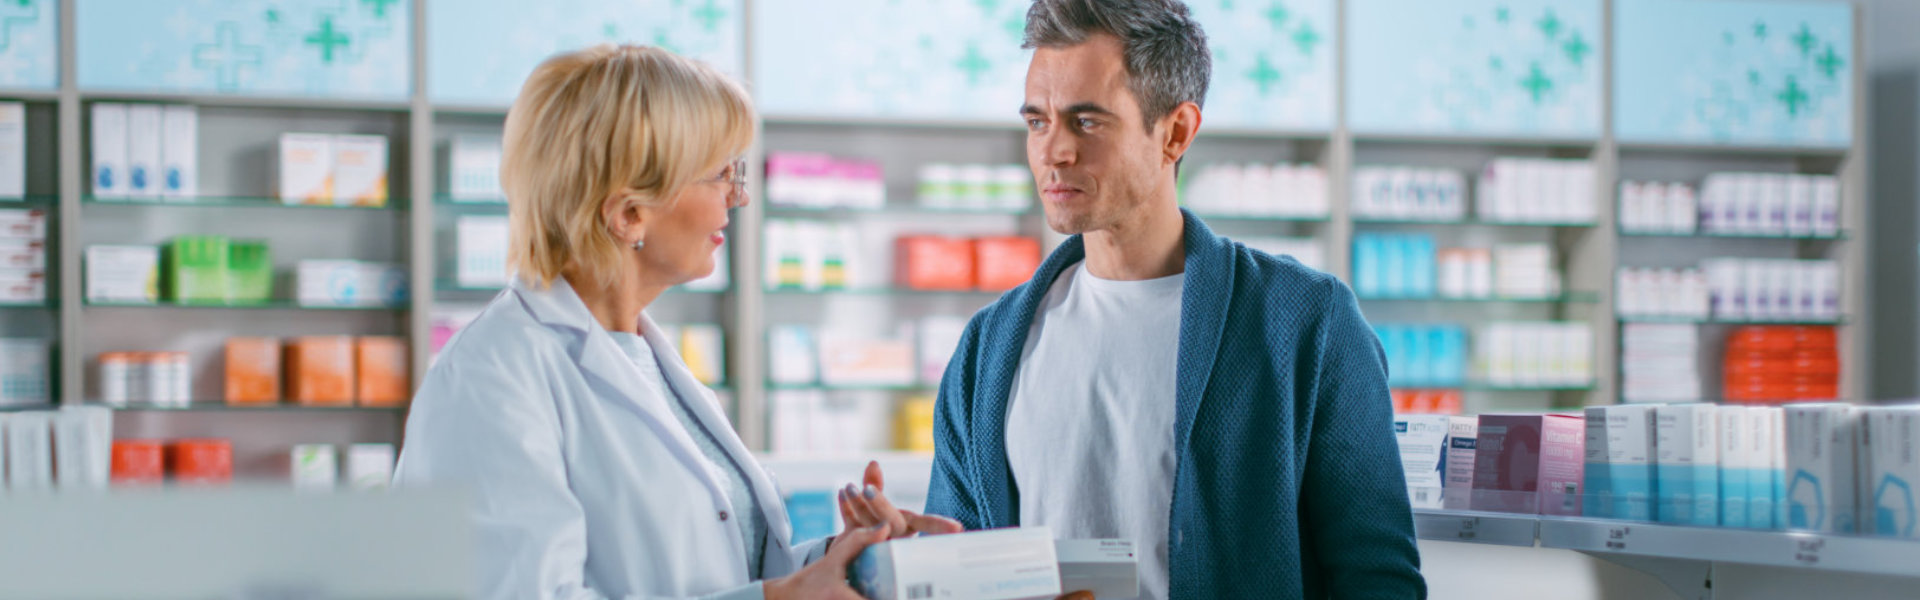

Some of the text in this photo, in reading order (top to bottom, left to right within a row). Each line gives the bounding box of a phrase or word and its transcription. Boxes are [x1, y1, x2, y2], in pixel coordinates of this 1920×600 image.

[1451, 422, 1472, 432] FATTY
[1545, 430, 1582, 444] Vitamin C
